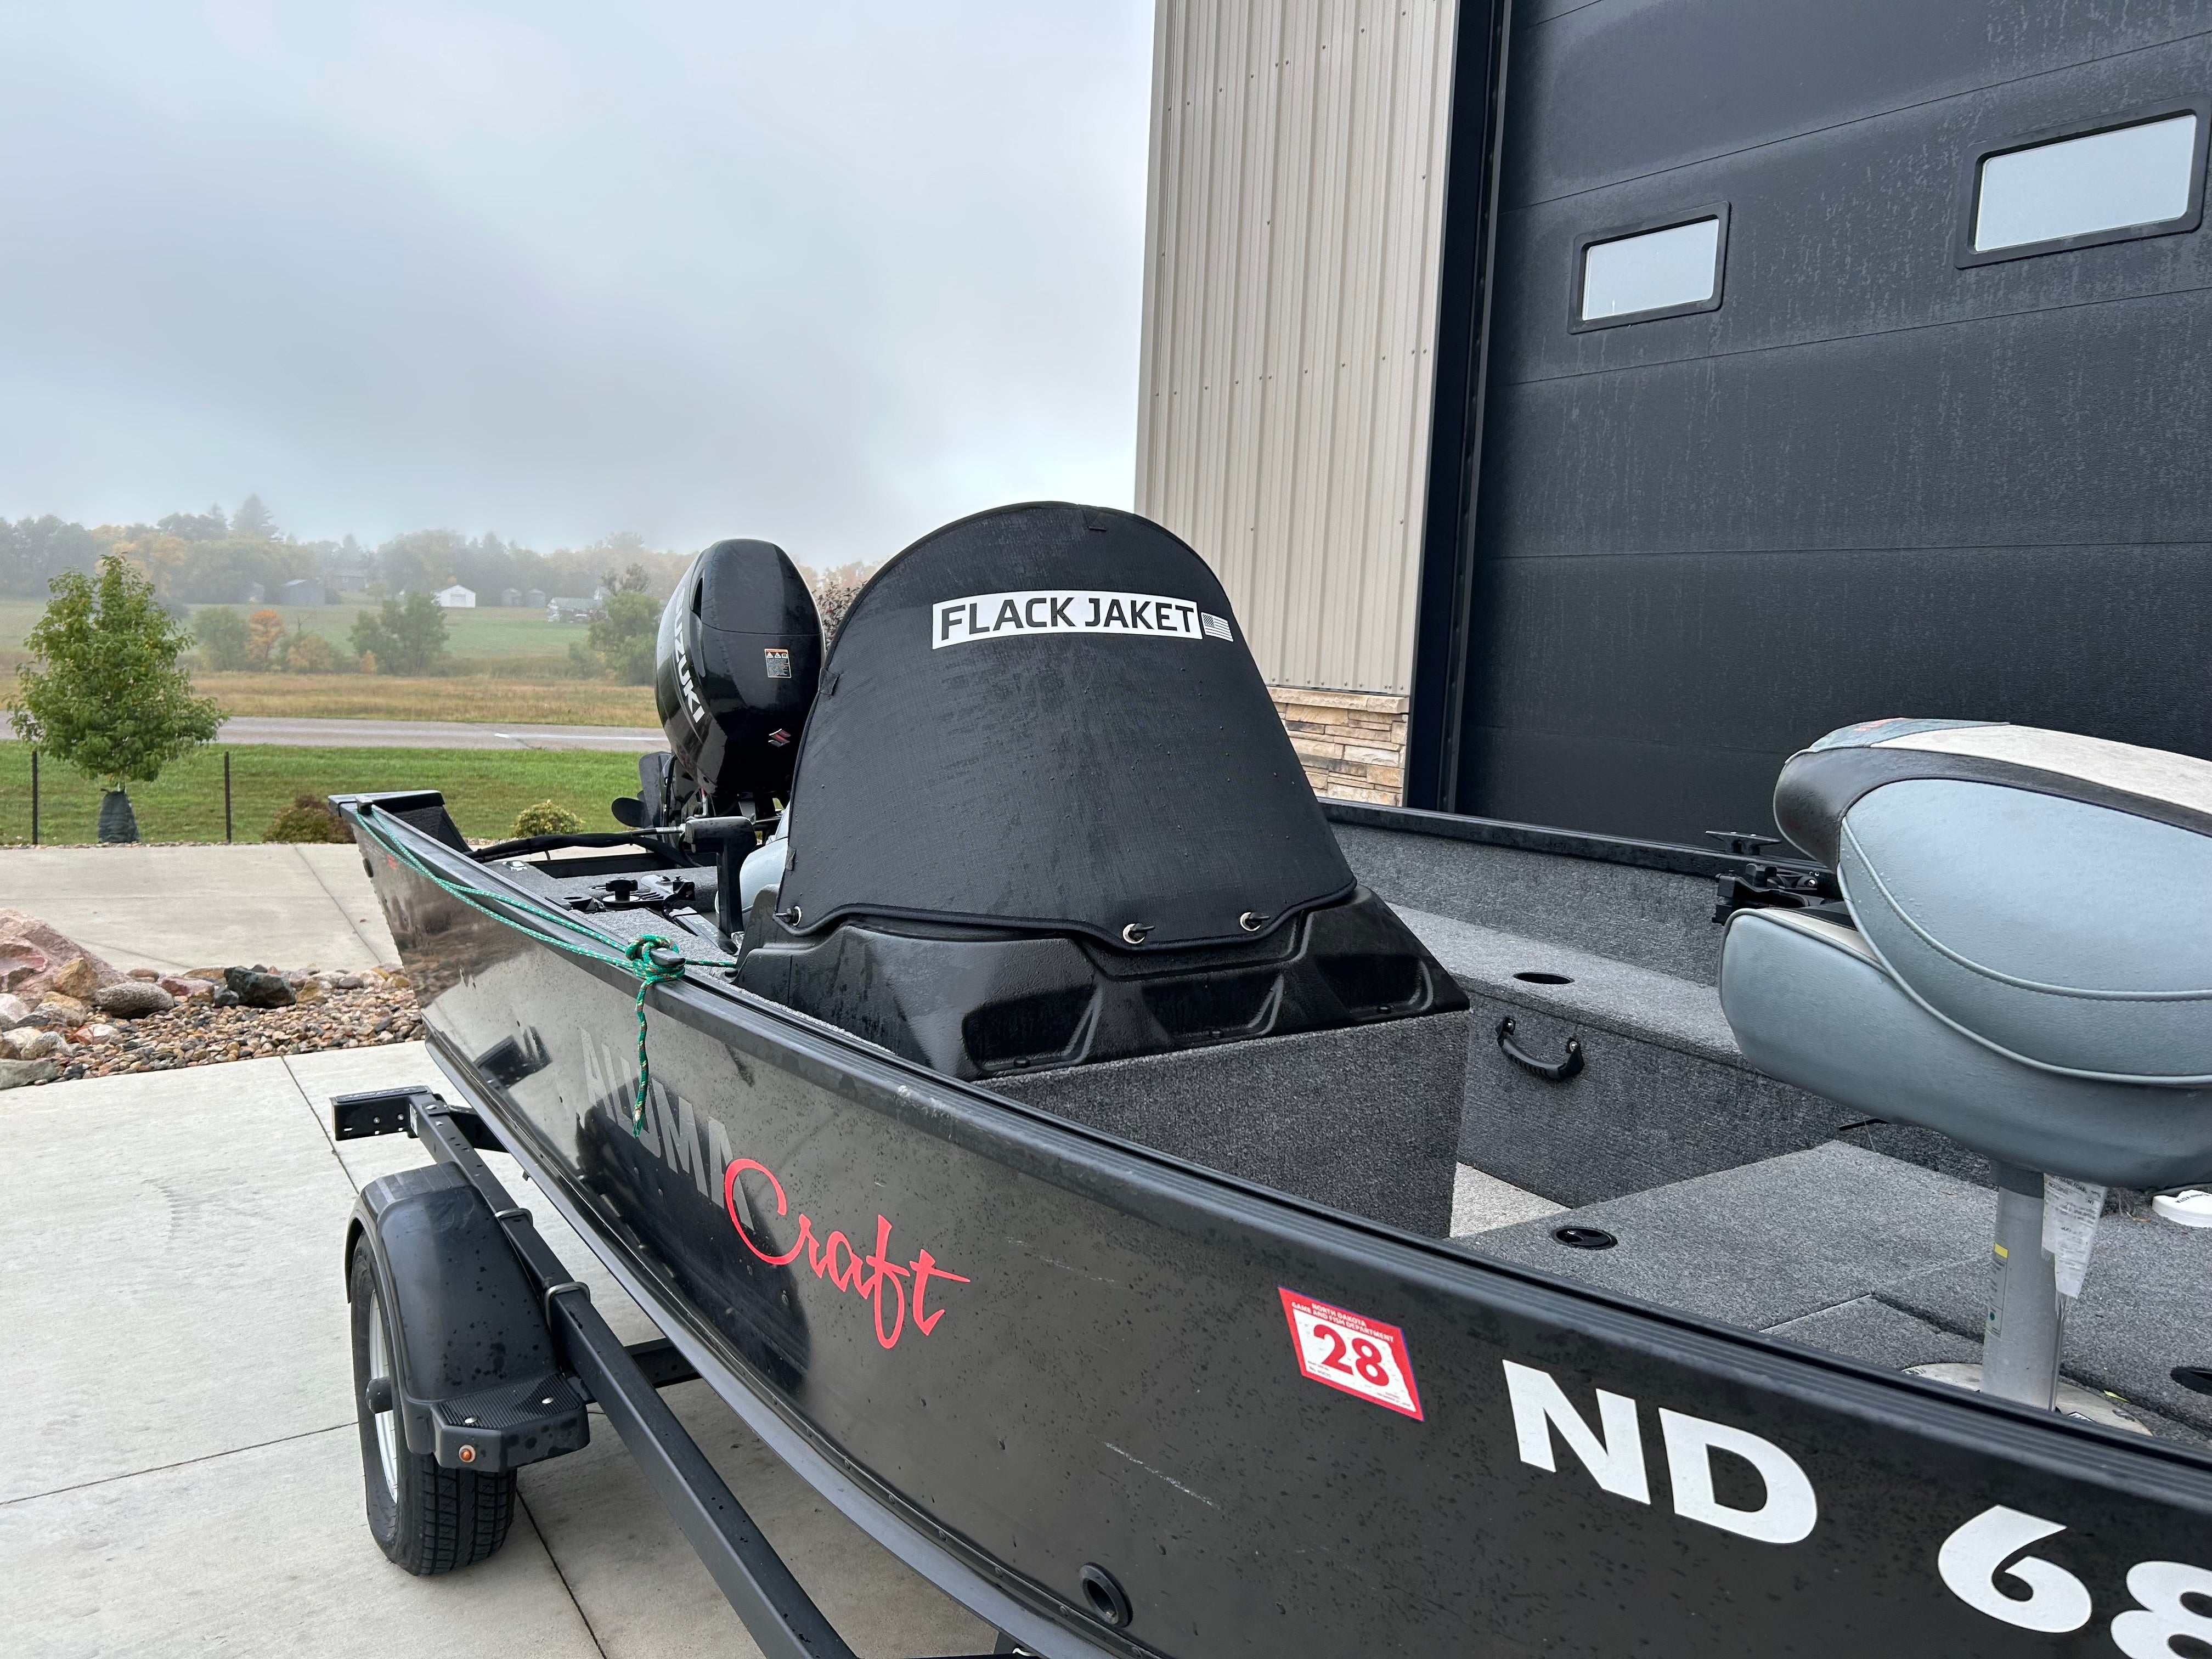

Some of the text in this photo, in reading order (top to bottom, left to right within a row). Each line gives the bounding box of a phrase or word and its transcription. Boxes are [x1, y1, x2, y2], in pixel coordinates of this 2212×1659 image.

[941, 597, 1194, 641] FLACK JAKET
[675, 588, 705, 723] SUZUKI
[724, 1158, 970, 1349] Craft
[1337, 1312, 1367, 1328] DAKOTA
[1346, 1321, 1394, 1343] DEPARTMENT
[1313, 1324, 1390, 1386] 28
[1502, 1359, 1818, 1544] ND
